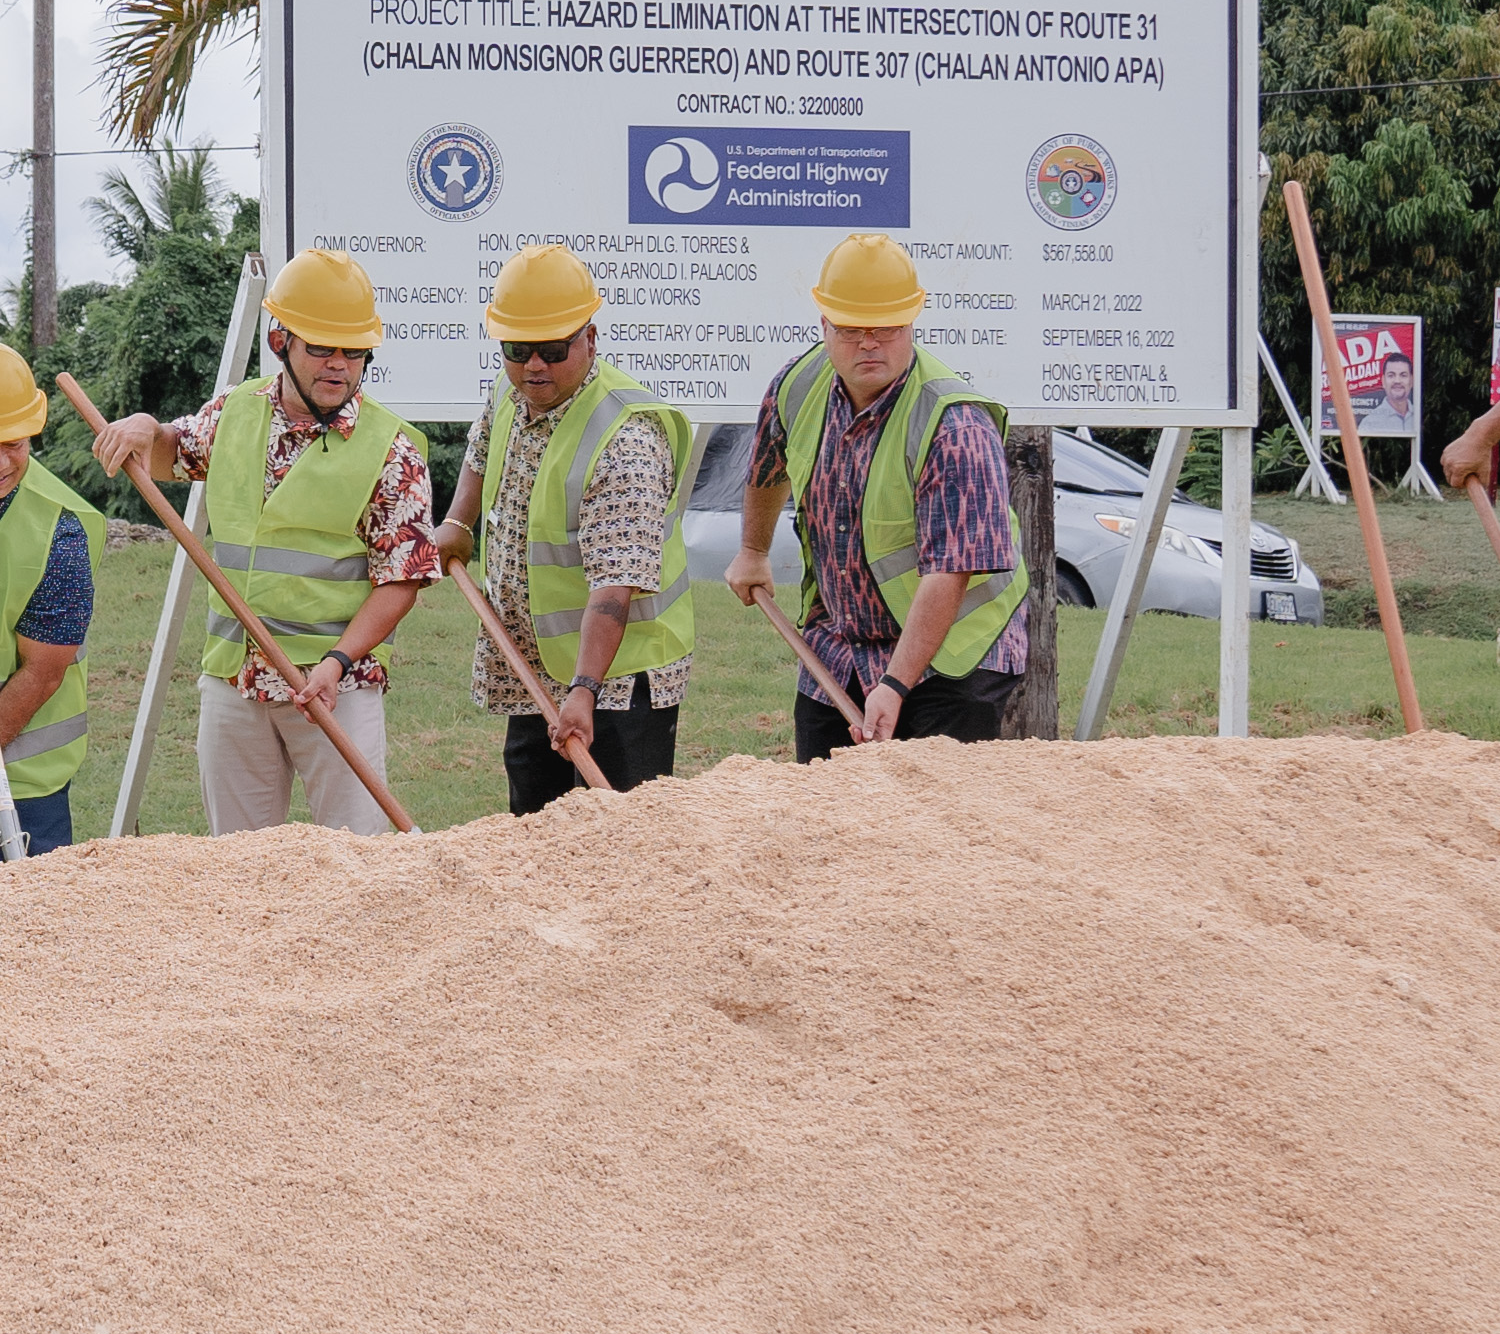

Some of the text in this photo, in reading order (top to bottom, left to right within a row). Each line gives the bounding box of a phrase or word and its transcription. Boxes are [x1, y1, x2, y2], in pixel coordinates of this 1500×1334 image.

[477, 0, 541, 28] TITLE:
[547, 0, 638, 28] HAZARD
[644, 2, 779, 32] ELIMINATION
[785, 5, 815, 33] AT
[818, 6, 861, 34] THE
[866, 7, 1019, 37] INTERSECTION
[1026, 10, 1054, 38] OF
[1061, 11, 1132, 40] ROUTE
[1137, 13, 1159, 41] 31
[363, 41, 1165, 91] (CHALAN MONSIGNOR GUERRERO) AND ROUTE 307 (CHALAN ANTONIO APA)
[676, 93, 864, 116] CONTRACT NO.: 32200800
[431, 126, 447, 137] THE
[447, 125, 486, 142] NORTHERN
[485, 140, 502, 175] MARIANA
[726, 145, 888, 159] U.S. Department of Transportation
[408, 141, 426, 204] COMMONWEALTH
[726, 160, 889, 185] Federal Highway
[1028, 136, 1115, 190] DEPARTMENT OF PUBLIC WORKS
[485, 175, 502, 205] ISLANDS
[726, 188, 862, 208] Administration
[429, 206, 480, 220] OFFICIAL SEAL
[1034, 201, 1058, 223] SAIPAN
[1061, 218, 1090, 228] TINIAN
[313, 235, 427, 253] CNMI GOVERNOR:
[478, 233, 750, 254] HON. GOVERNOR RALPH DLG. TORRES &
[897, 242, 1012, 261] NTRACT AMOUNT:
[1042, 244, 1114, 263] $567,558.00
[620, 262, 678, 280] ARNOLD
[680, 263, 688, 281] I.
[690, 263, 758, 282] PALACIOS
[410, 287, 467, 304] AGENCY:
[598, 287, 701, 306] PUBLIC WORKS
[935, 293, 952, 309] TO
[955, 293, 1017, 310] PROCEED:
[1042, 294, 1142, 315] MARCH 21, 2022
[410, 323, 469, 341] OFFICER:
[609, 323, 693, 342] SECRETARY
[696, 324, 714, 342] OF
[717, 325, 766, 343] PUBLIC
[768, 326, 820, 344] WORKS
[912, 328, 1008, 346] PLETION DATE:
[1042, 329, 1175, 349] SEPTEMBER 16, 2022
[605, 353, 750, 372] OF TRANSPORTATION
[371, 367, 392, 383] BY:
[1042, 364, 1168, 382] HONG YE RENTAL &
[1041, 384, 1180, 404] CONSTRUCTION, LTD.
